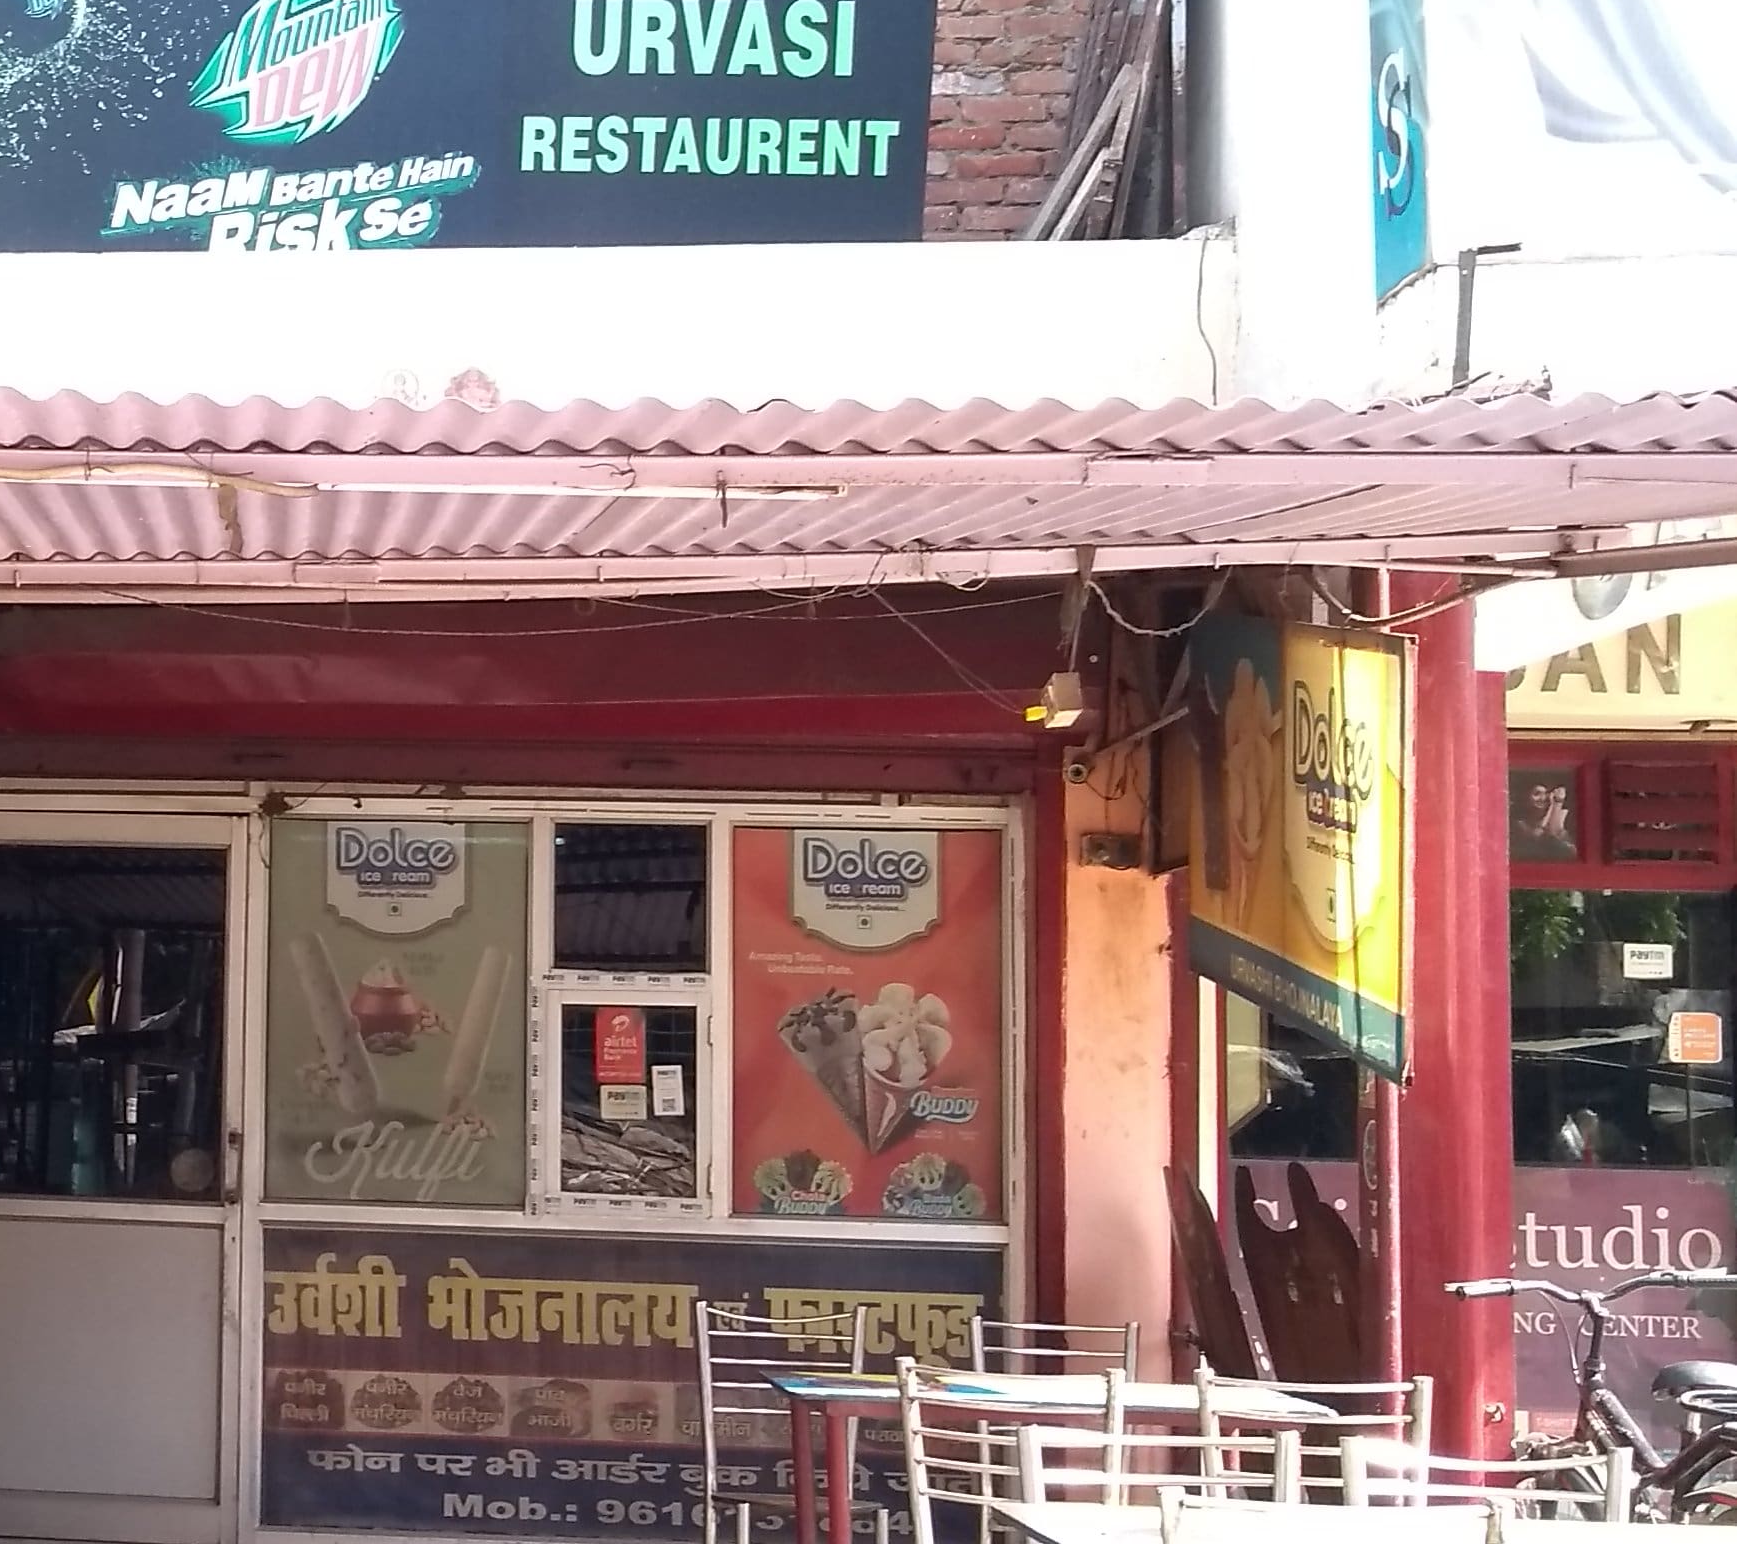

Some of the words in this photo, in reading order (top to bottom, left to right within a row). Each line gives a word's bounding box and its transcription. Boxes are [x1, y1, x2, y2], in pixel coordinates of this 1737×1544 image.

[397, 151, 477, 189] Hain
[520, 115, 901, 176] RESTAURENT
[207, 198, 361, 253] Risk
[359, 195, 435, 242] Se
[1506, 613, 1682, 695] AN
[1294, 679, 1374, 801] Dolce
[337, 828, 456, 870] Dolce
[804, 838, 928, 883] Dolce
[305, 1120, 485, 1201] Kulfi
[1509, 1205, 1722, 1270] tudio
[263, 1252, 407, 1339] उर्वशी
[427, 1257, 700, 1349] भोजनालय
[1578, 1314, 1702, 1339] CENTER
[307, 1443, 404, 1473] फोन
[414, 1453, 476, 1476] पर
[485, 1448, 540, 1478] भी
